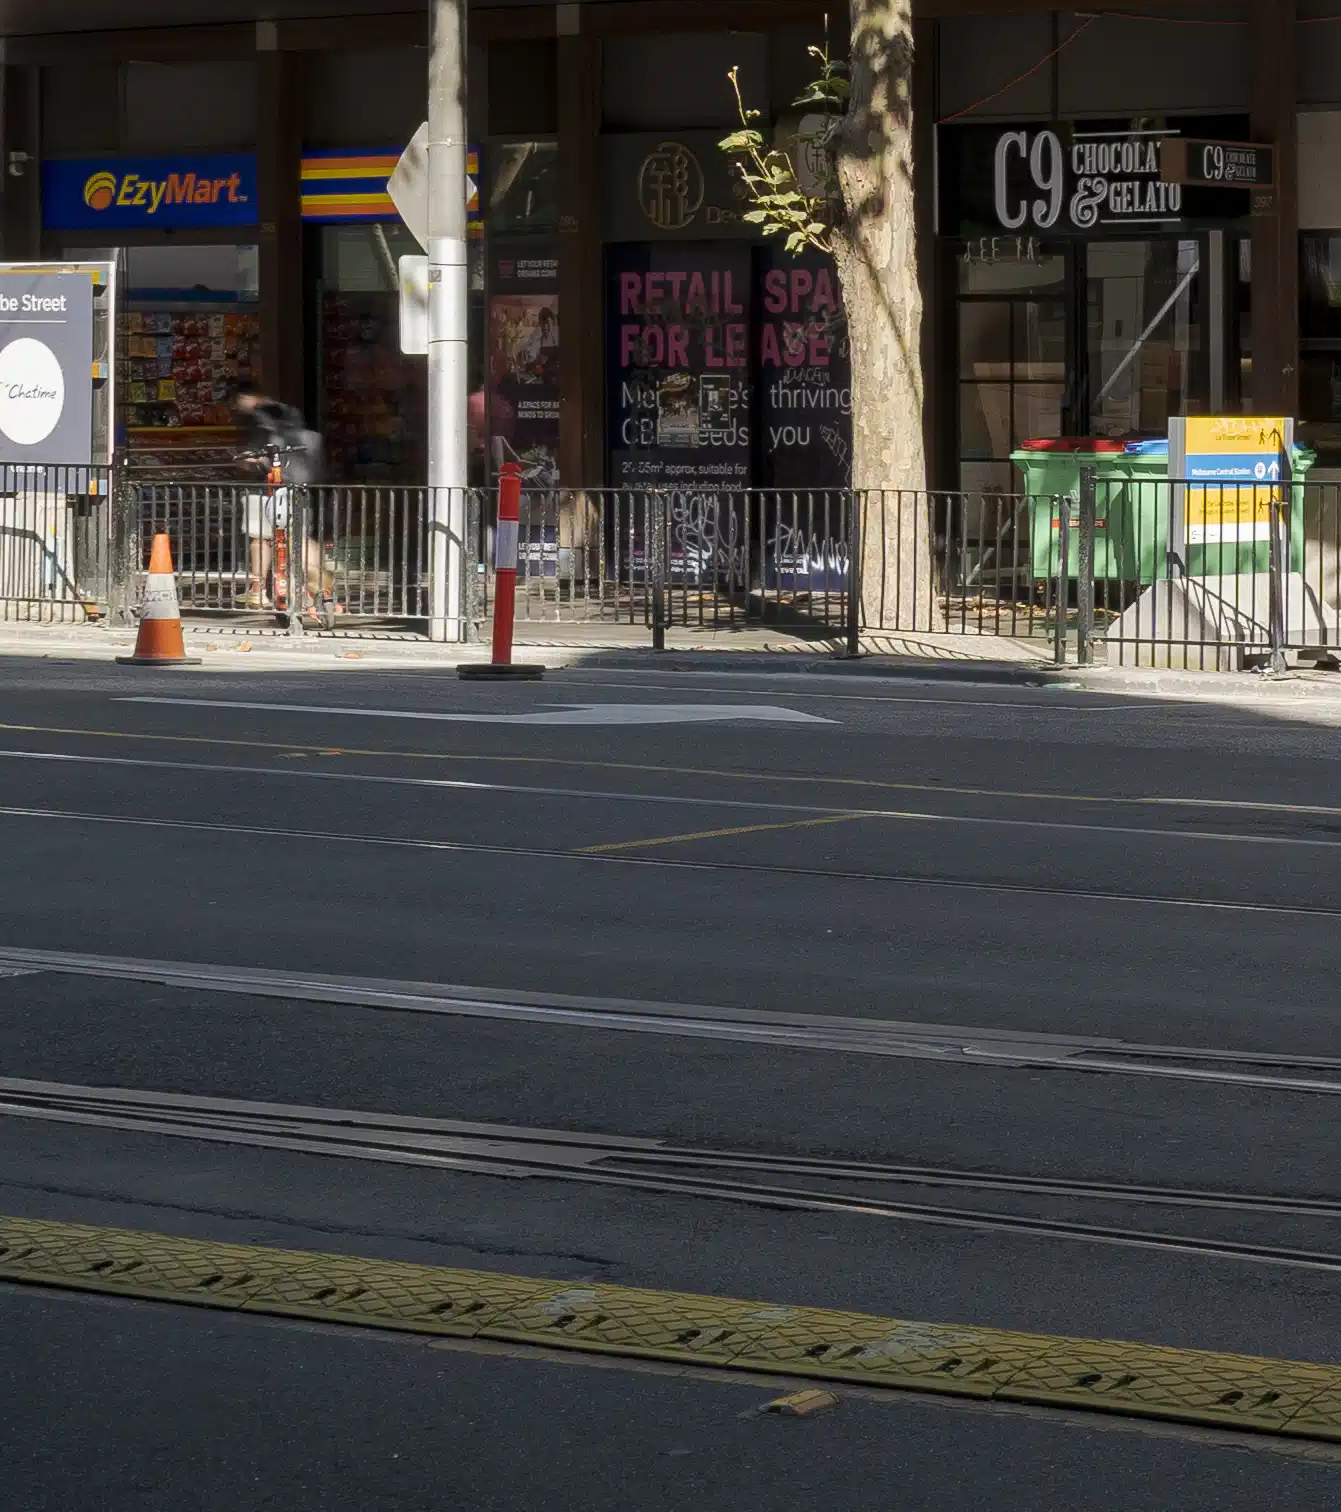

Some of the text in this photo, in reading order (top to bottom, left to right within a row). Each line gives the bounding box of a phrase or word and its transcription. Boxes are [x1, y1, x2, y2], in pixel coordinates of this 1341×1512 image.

[994, 130, 1064, 228] C9
[1203, 145, 1224, 180] C9
[116, 172, 240, 214] EzyMart
[1108, 181, 1181, 213] GELATO
[22, 294, 67, 312] Street
[619, 267, 837, 315] RETAIL SPA
[620, 323, 690, 368] FOR
[9, 384, 57, 400] Chatime
[770, 378, 853, 414] thriving
[770, 425, 811, 449] you
[698, 462, 733, 475] suitable
[734, 463, 748, 475] for
